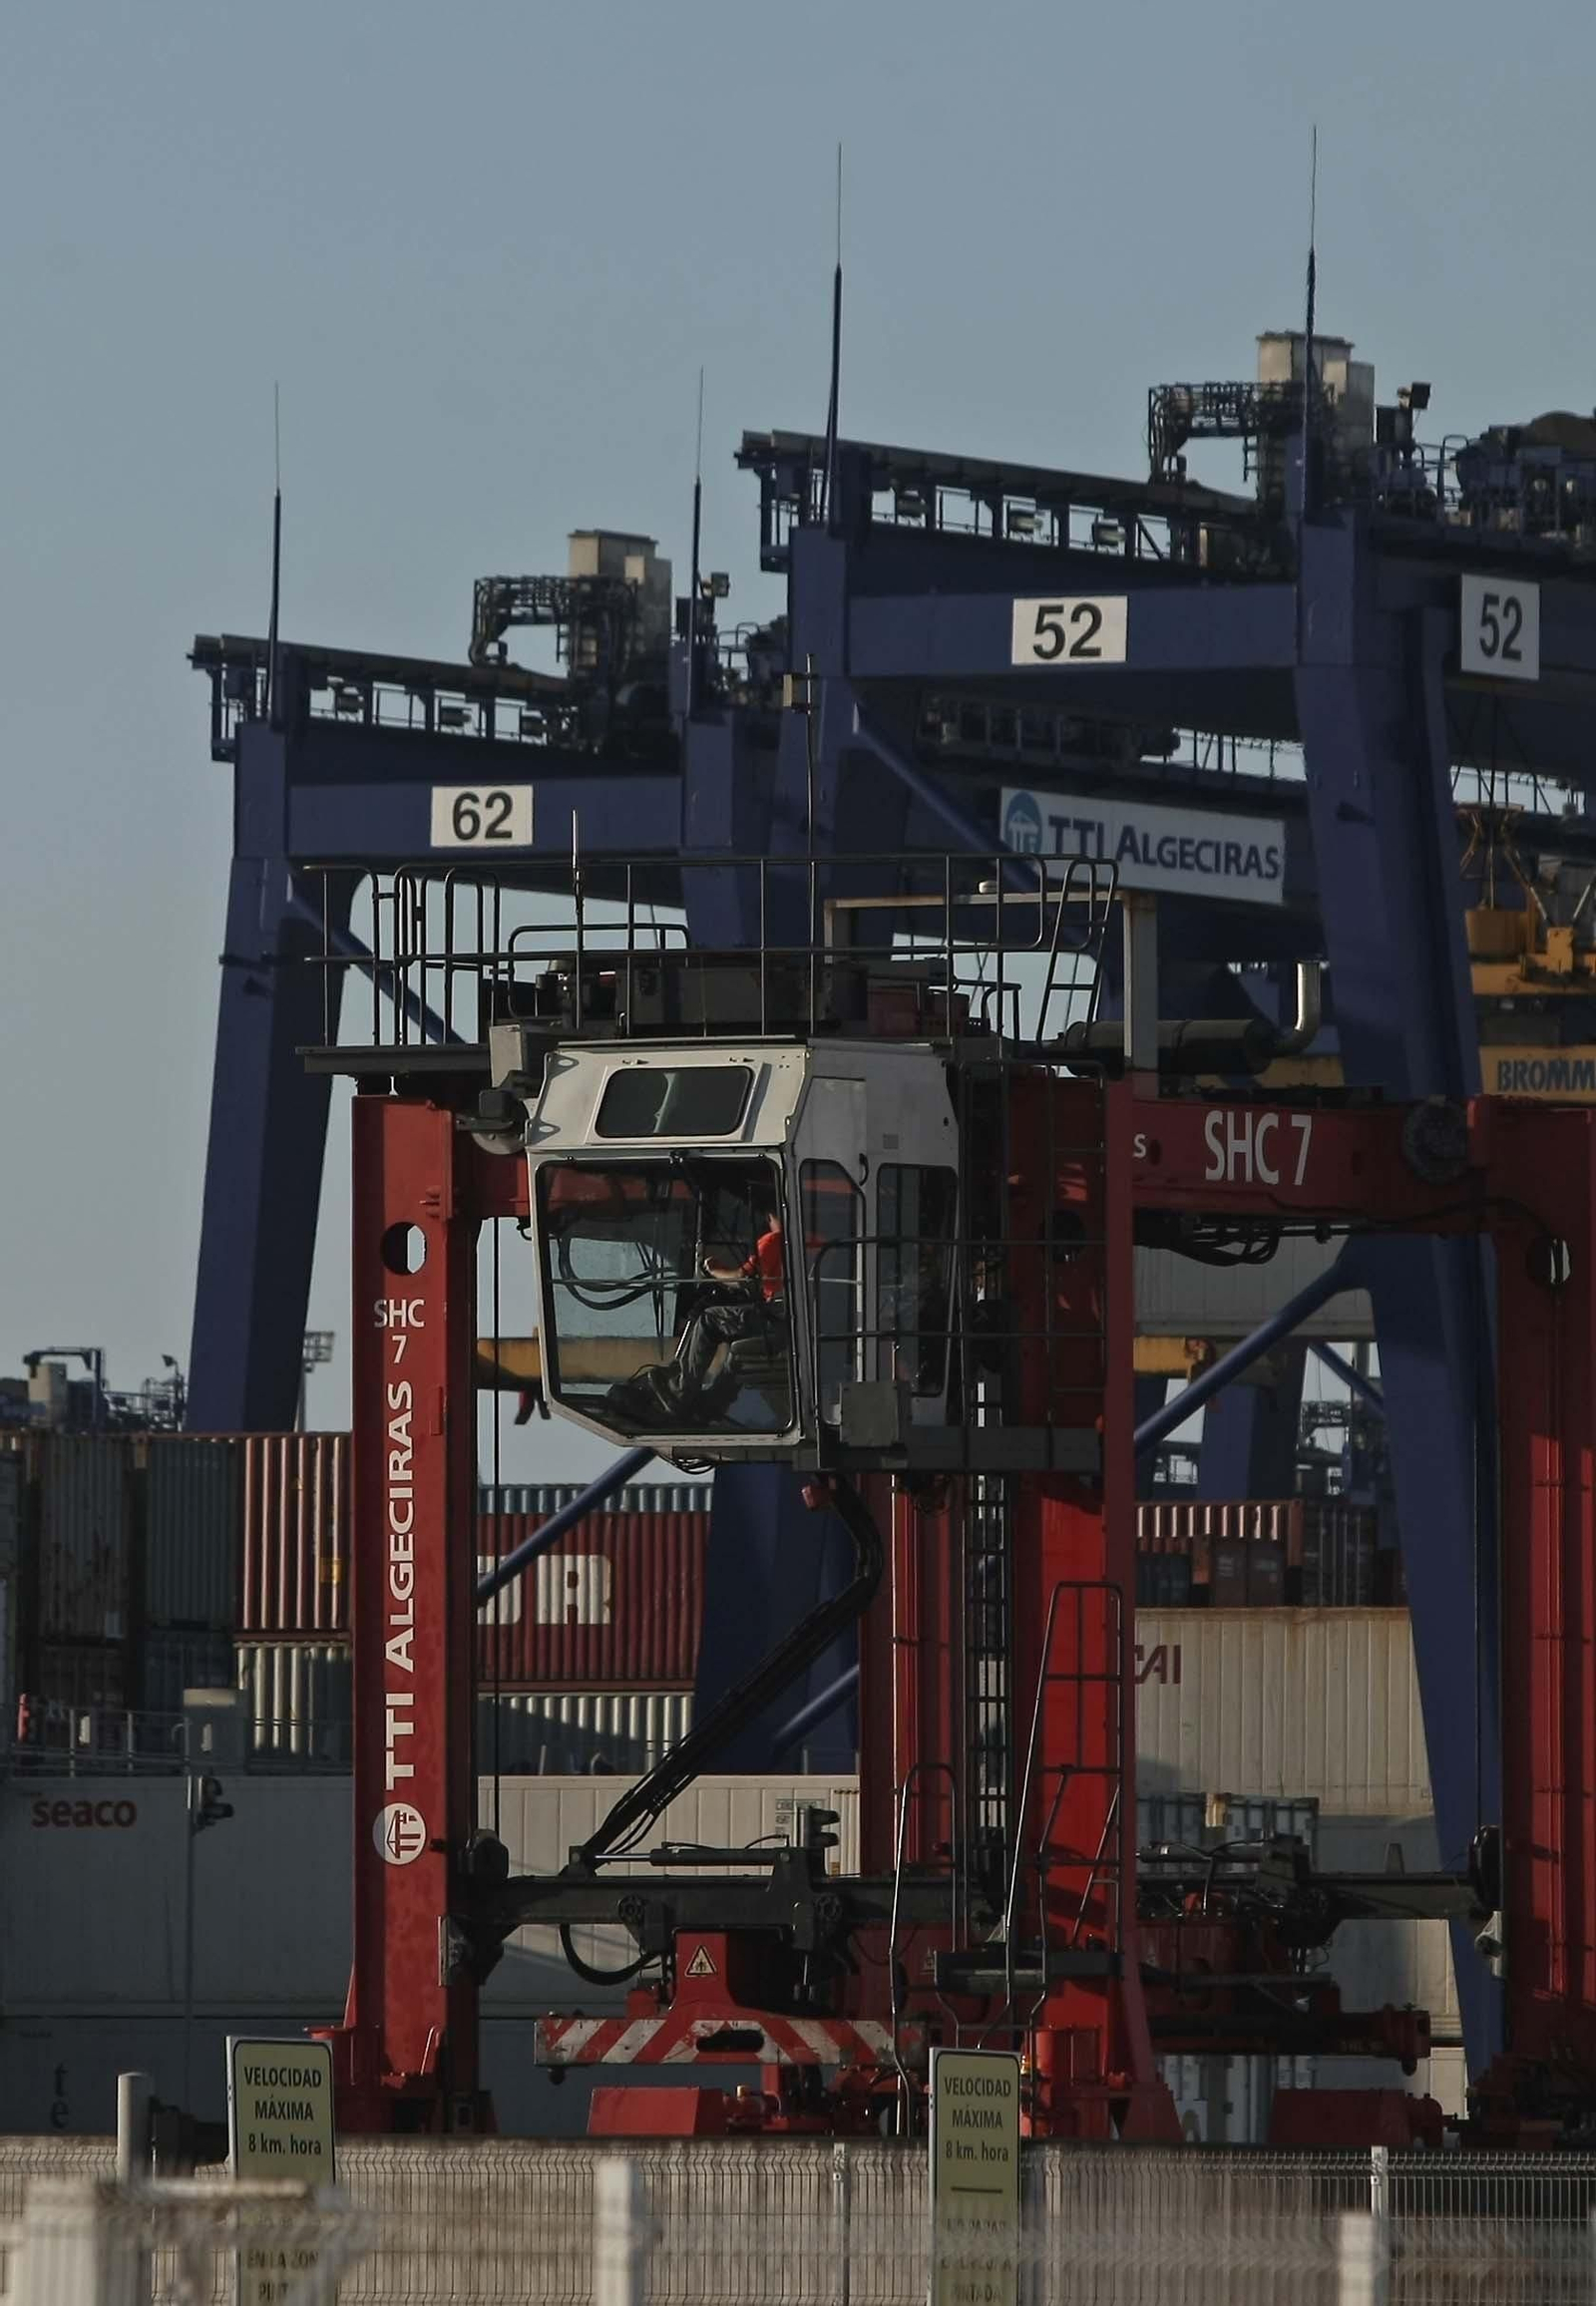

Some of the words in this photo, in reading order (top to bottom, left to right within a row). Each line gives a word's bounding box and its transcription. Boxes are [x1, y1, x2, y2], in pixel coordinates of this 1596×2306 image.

[1033, 602, 1102, 660] 52
[1479, 593, 1522, 662] 52
[452, 791, 513, 841] 62
[1048, 814, 1105, 860] TTI
[1117, 824, 1281, 880] ALGECIRAS
[1204, 1109, 1280, 1185] SHC
[1291, 1113, 1314, 1186] 7
[373, 1298, 426, 1329] SHC
[391, 1335, 408, 1364] 7
[384, 1379, 415, 1674] ALGECIRAS
[385, 1692, 415, 1791] TTI
[31, 1799, 137, 1829] seaco
[243, 2066, 322, 2089] VELOCIDAD
[945, 2077, 1011, 2098] VELOCIDAD
[254, 2094, 314, 2121] MÁXIMA
[952, 2105, 1003, 2129] MÁXIMA
[248, 2134, 256, 2153] 8
[260, 2133, 286, 2155] km.
[290, 2134, 321, 2156] hora
[946, 2142, 953, 2160] 8
[957, 2140, 978, 2161] km.
[982, 2142, 1008, 2162] hora
